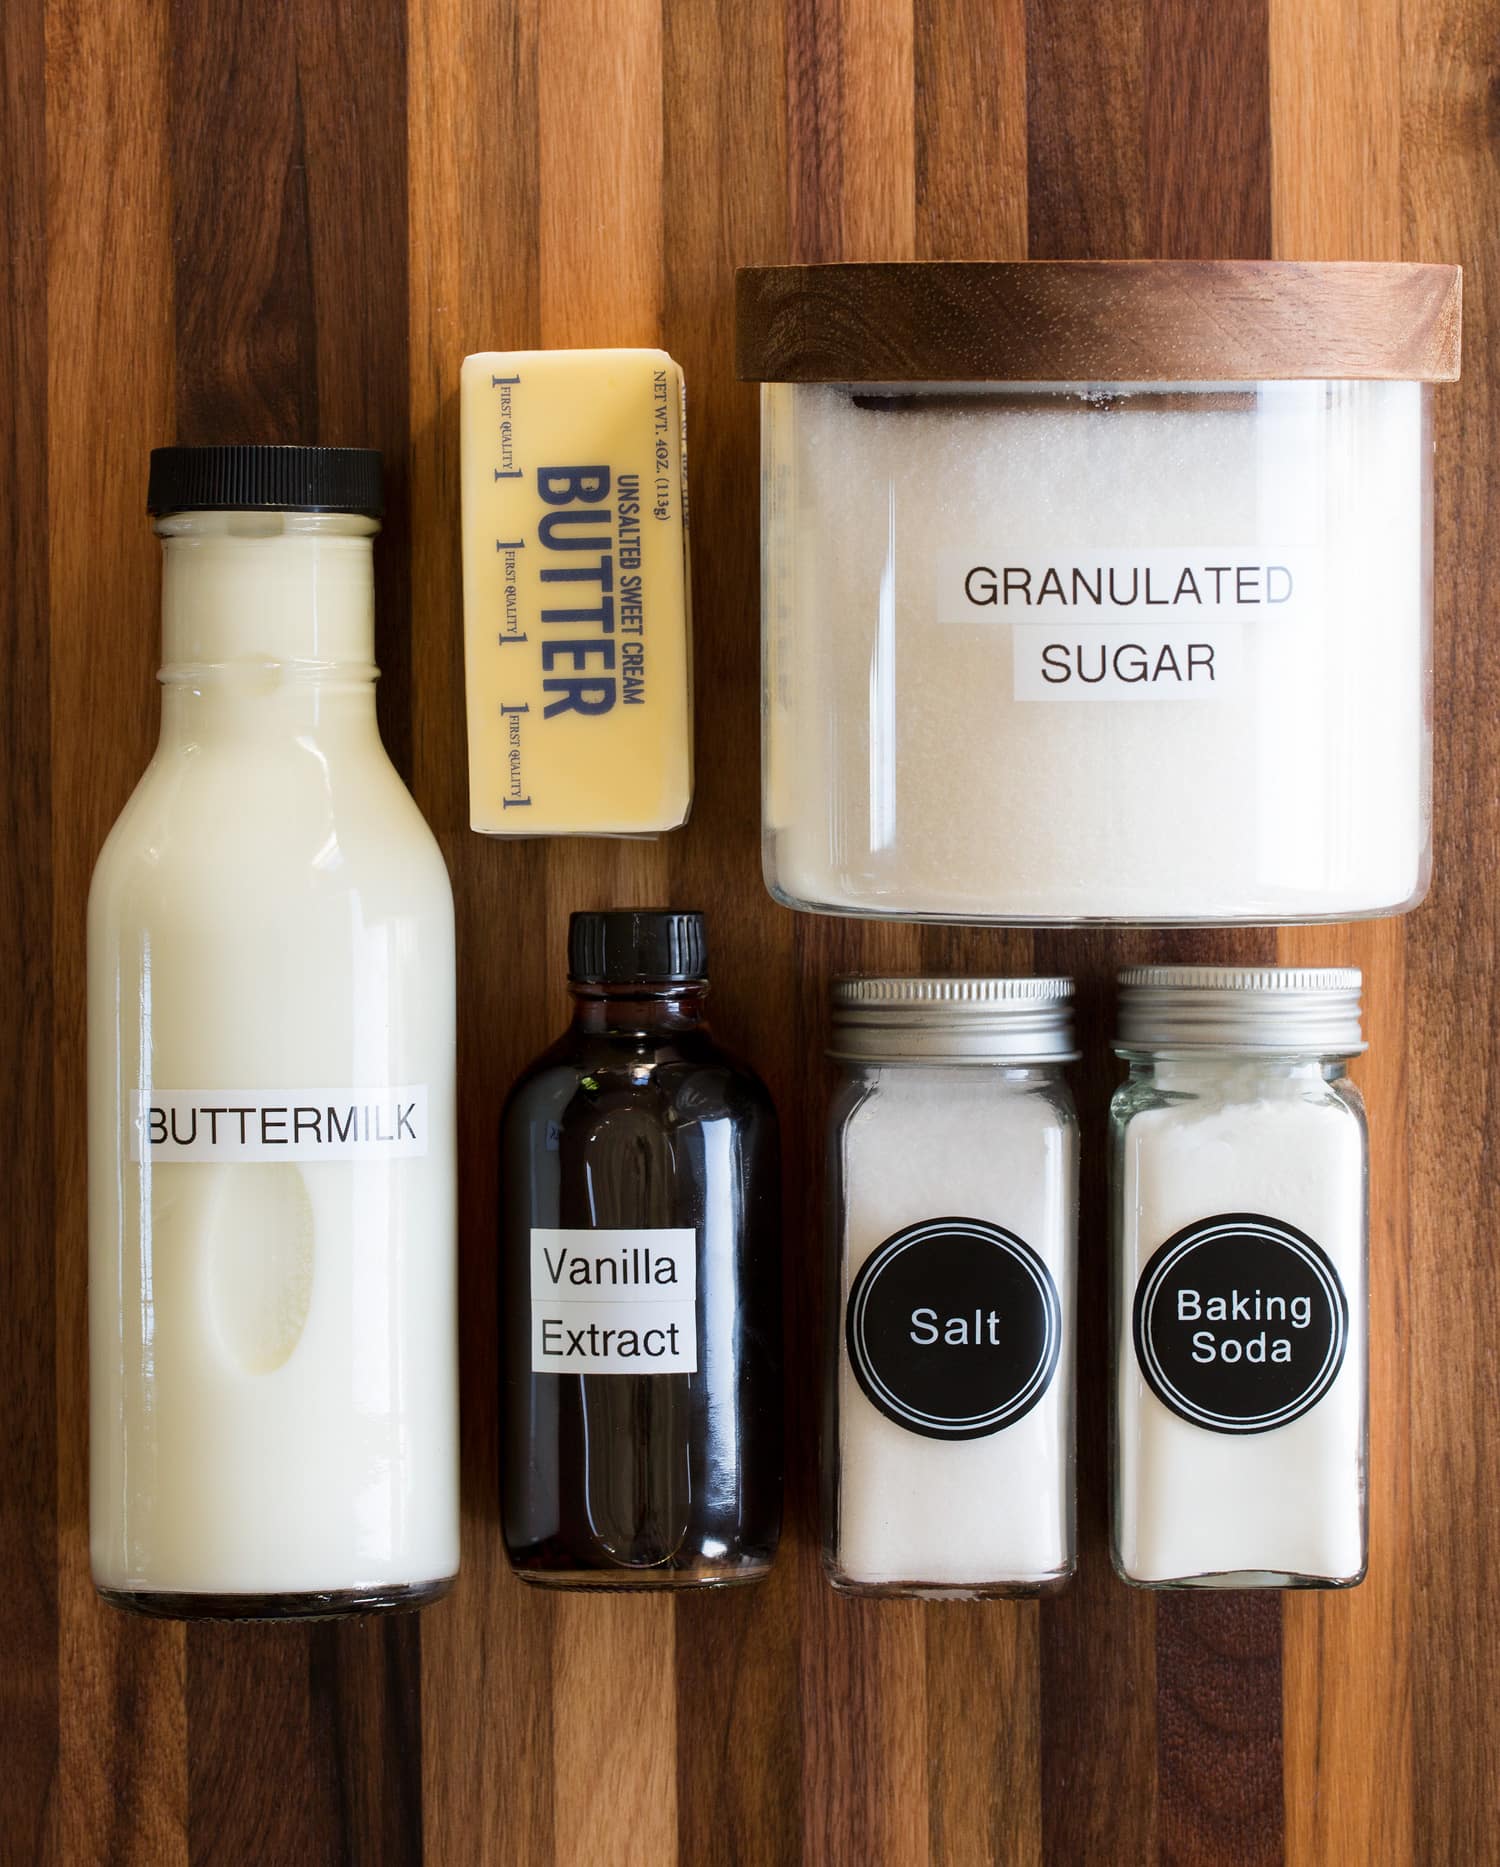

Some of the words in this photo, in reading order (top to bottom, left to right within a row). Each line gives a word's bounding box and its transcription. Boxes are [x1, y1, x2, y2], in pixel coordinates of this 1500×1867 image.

[500, 386, 512, 419] FIRST
[653, 370, 668, 404] NET
[654, 405, 669, 436] WT.
[499, 421, 512, 470] QUALITY
[653, 478, 671, 521] (113g)
[617, 474, 642, 570] UNSALTED
[504, 550, 516, 584] FIRST
[964, 565, 1293, 606] GRANULATED
[503, 585, 518, 634] QUALITY
[536, 465, 617, 720] BUTTER
[620, 576, 644, 636] SWEET
[621, 642, 646, 705] CREAM
[1040, 643, 1216, 684] SUGAR
[508, 715, 521, 747] FIRST
[507, 749, 522, 797] QUALITY
[146, 1102, 417, 1145] BUTTERMILK
[543, 1247, 678, 1285] Vanilla
[908, 1306, 1001, 1347] Salt
[1176, 1288, 1313, 1329] Baking
[542, 1319, 680, 1357] Extract
[1190, 1330, 1293, 1364] Soda
